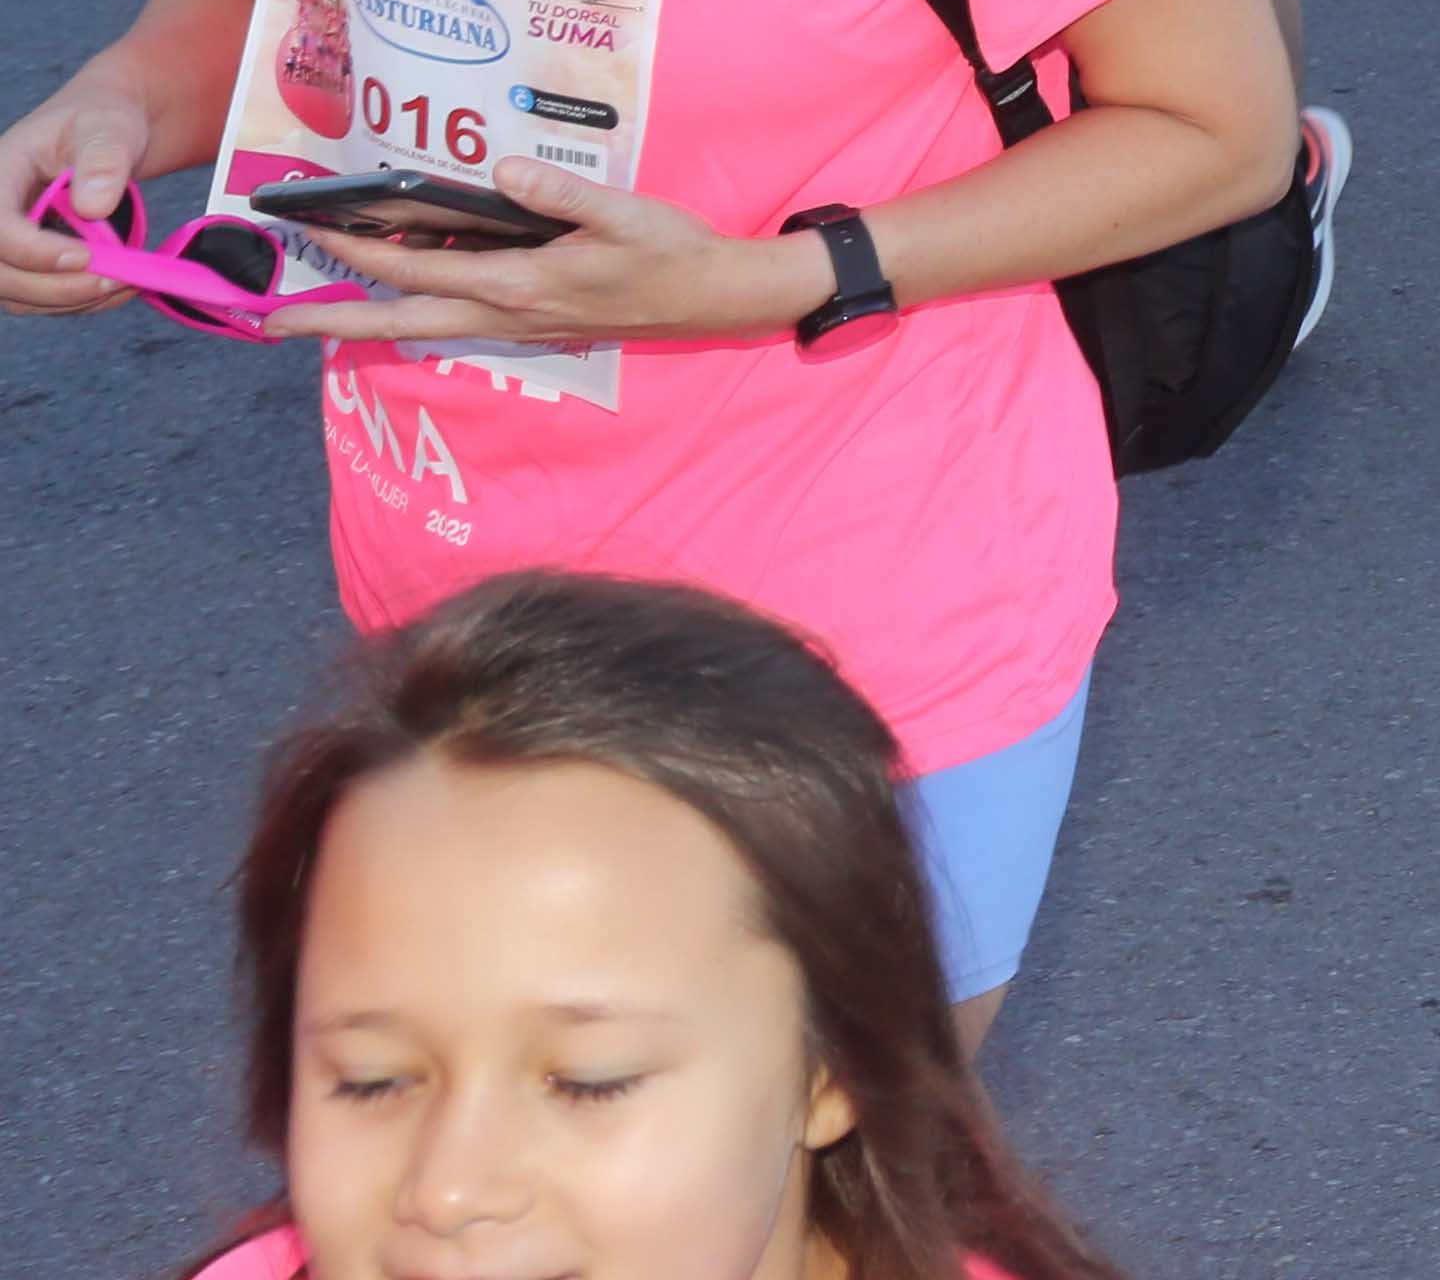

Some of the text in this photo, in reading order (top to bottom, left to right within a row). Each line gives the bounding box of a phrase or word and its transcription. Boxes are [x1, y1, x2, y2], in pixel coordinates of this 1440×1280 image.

[527, 0, 621, 29] TU DORSAL
[527, 16, 616, 53] SUMA
[361, 76, 489, 166] 016
[327, 365, 468, 506] UMA
[424, 507, 472, 547] 2023
